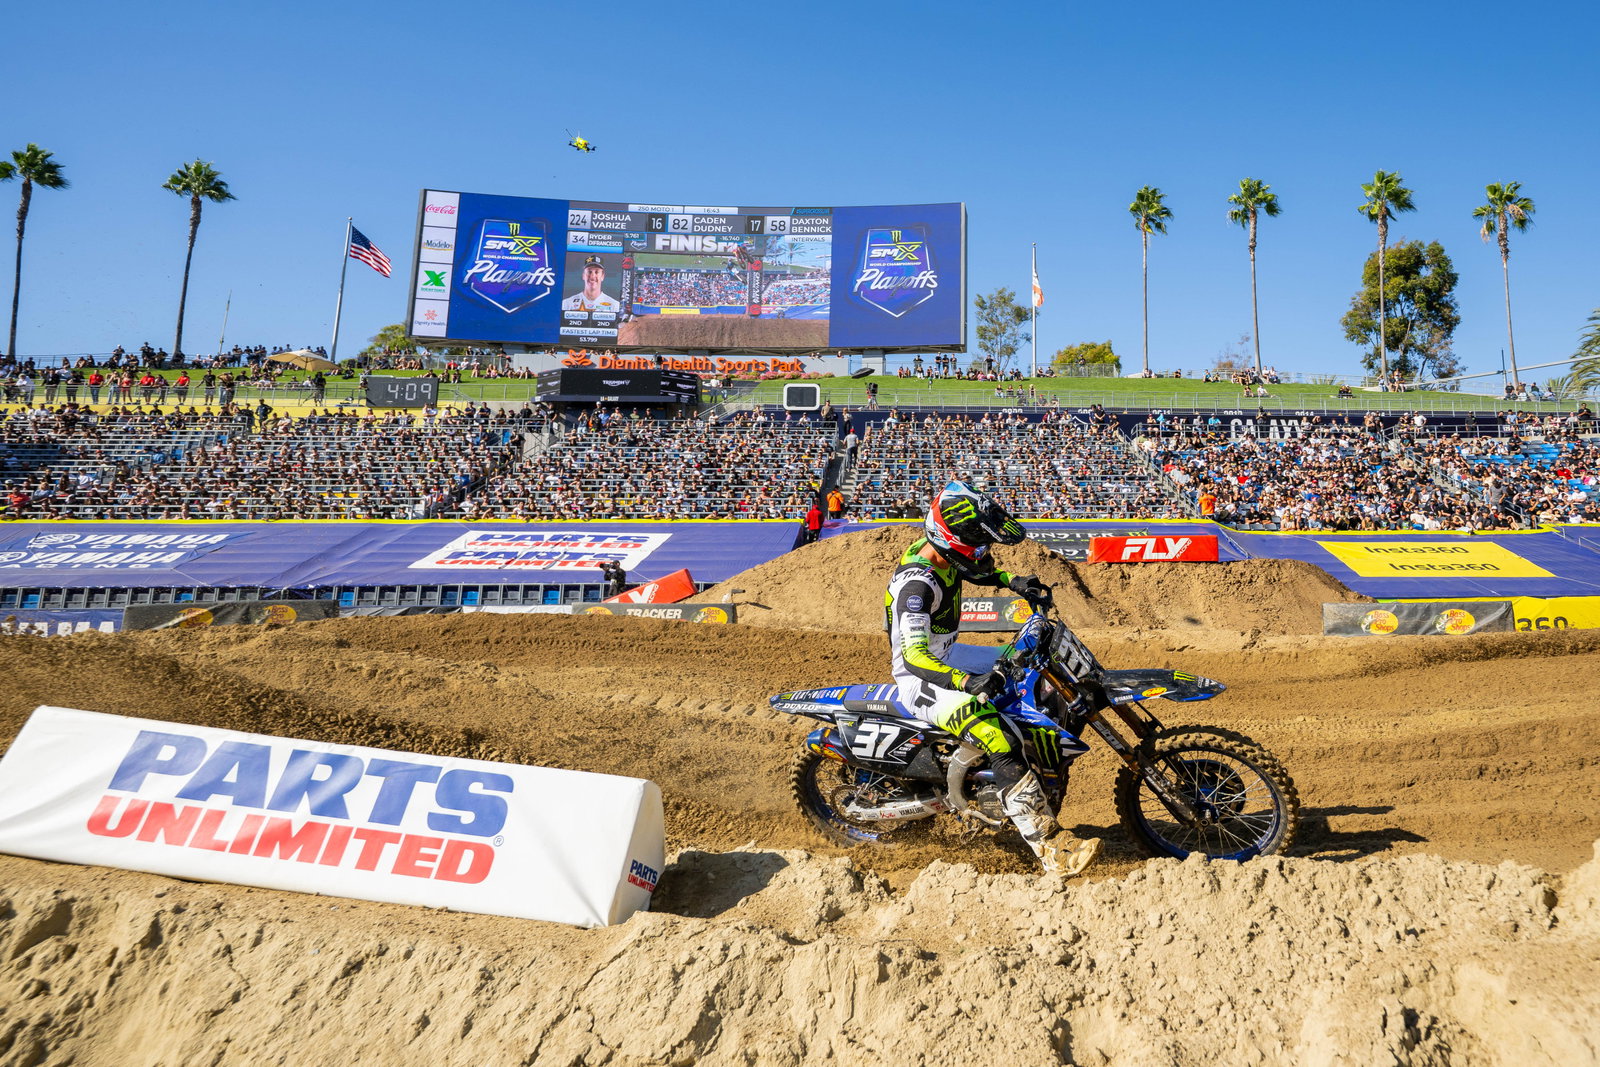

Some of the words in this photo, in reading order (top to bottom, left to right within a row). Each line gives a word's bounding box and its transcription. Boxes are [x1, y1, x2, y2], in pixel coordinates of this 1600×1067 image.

[569, 213, 588, 226] 224
[592, 213, 632, 222] JOSHUA
[693, 216, 727, 225] CADEN
[792, 217, 829, 226] DAXTON
[592, 221, 628, 230] VARIZE
[651, 217, 663, 230] 16
[672, 218, 689, 230] 82
[693, 224, 734, 233] DUDNEY
[750, 219, 761, 232] 17
[770, 220, 786, 232] 58
[791, 225, 832, 234] BENNICK
[572, 234, 585, 244] 34
[589, 233, 612, 241] RYDER
[426, 240, 450, 248] Modelo
[483, 238, 540, 256] SMX
[869, 244, 921, 261] SMX
[463, 259, 555, 292] Playoffs
[853, 268, 938, 296] Playoffs
[599, 356, 655, 369] Dignity
[661, 357, 712, 370] Health
[715, 358, 766, 373] Sports
[770, 358, 802, 371] Park
[388, 383, 432, 400] 4:09
[73, 534, 230, 544] YAMAHA
[475, 533, 650, 543] PARTS
[466, 541, 644, 549] UNLIMITED
[1121, 537, 1190, 560] FLY
[1364, 546, 1470, 554] Insta360
[19, 551, 187, 564] YAMAHA
[443, 550, 629, 560] PARTS
[435, 559, 604, 568] UNLIMITE
[1388, 562, 1501, 571] Insta360
[961, 601, 993, 612] CKER
[626, 608, 683, 619] TRACKER
[1374, 623, 1394, 632] Shops
[1450, 623, 1473, 632] Shops
[866, 703, 887, 711] YAMAHA
[852, 723, 900, 759] 37
[108, 730, 515, 839] PARTS
[86, 795, 496, 884] UNLIMITED
[630, 859, 658, 884] PARTS
